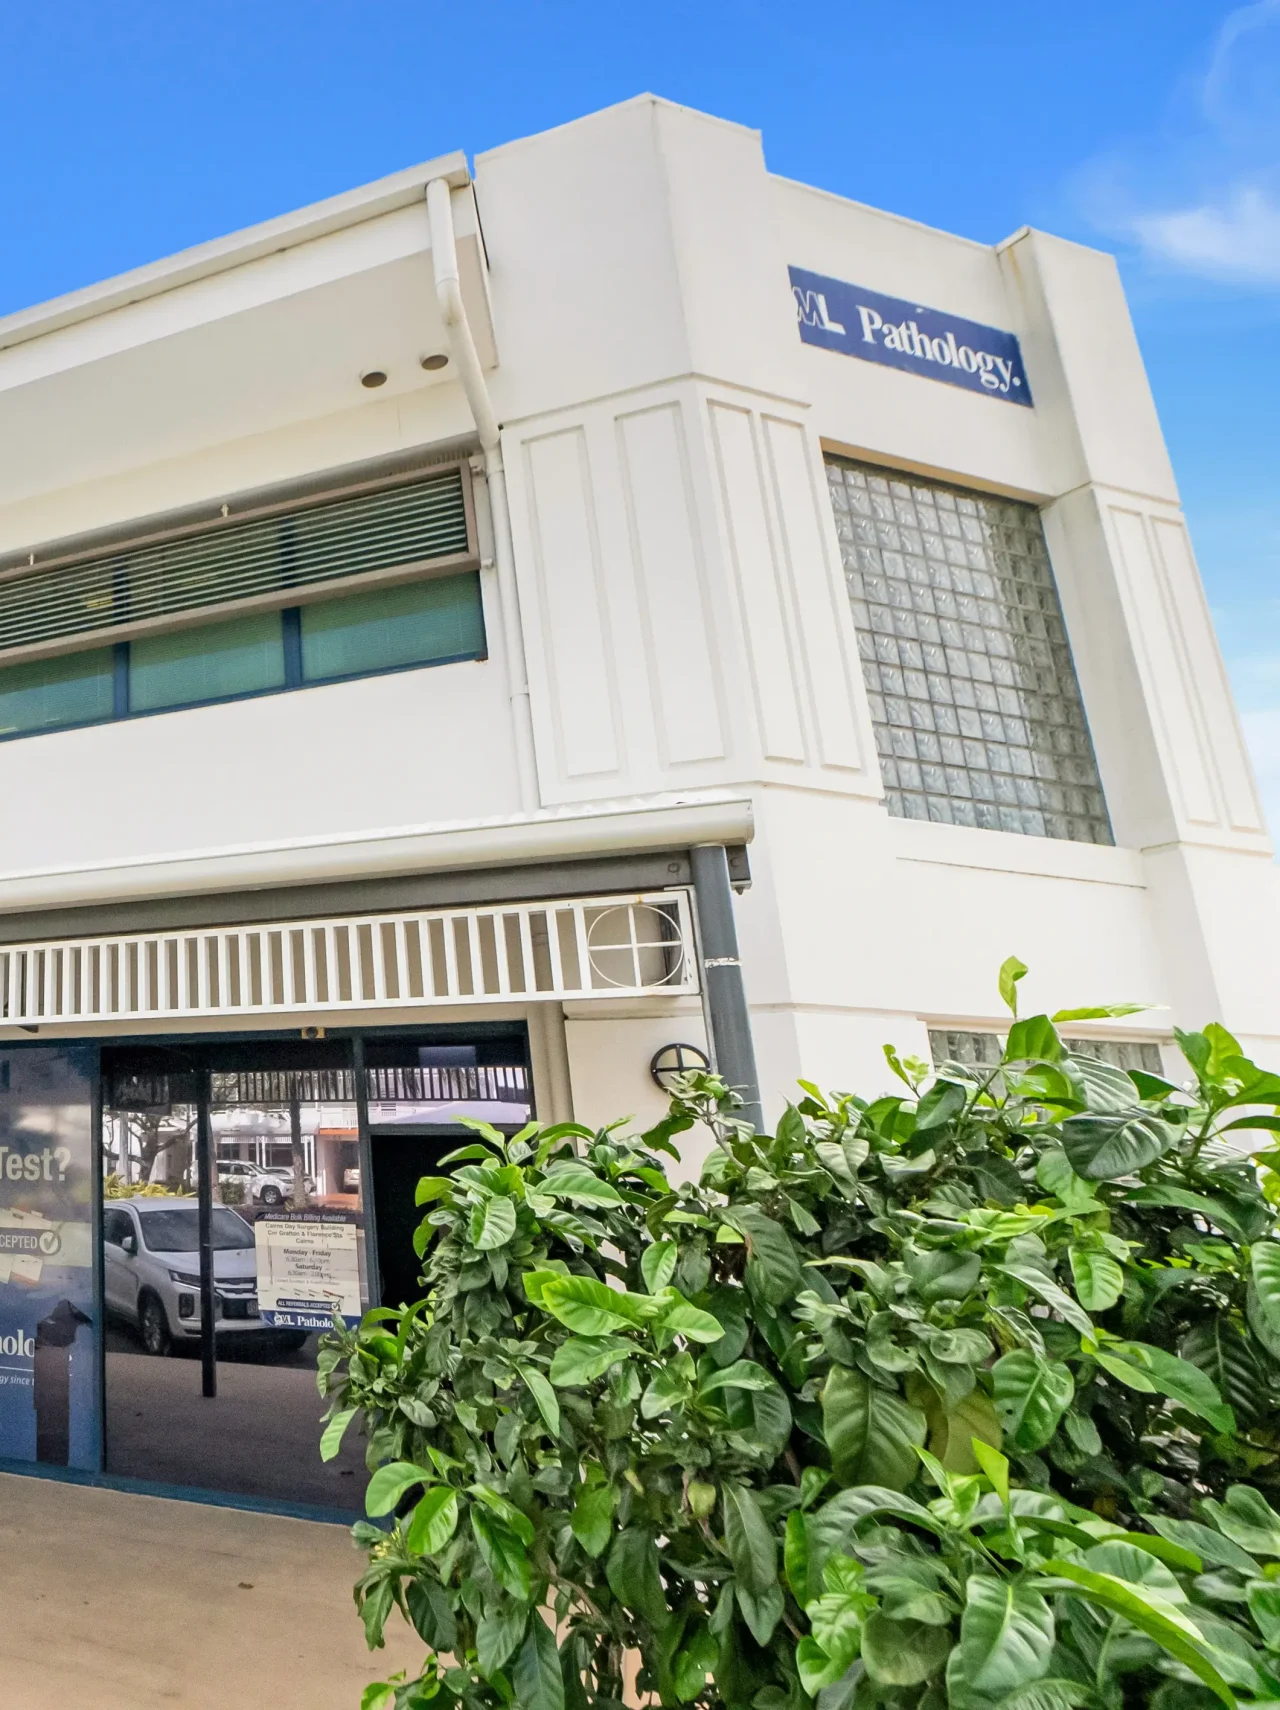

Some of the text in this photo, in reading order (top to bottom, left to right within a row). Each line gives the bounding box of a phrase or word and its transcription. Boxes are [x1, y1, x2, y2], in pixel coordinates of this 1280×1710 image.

[791, 286, 1021, 393] ML Pathology.
[264, 1213, 290, 1221] Medicare
[283, 1249, 308, 1257] Monday
[295, 1263, 323, 1271] Saturday
[297, 1315, 334, 1329] Patholo
[10, 1376, 30, 1386] since
